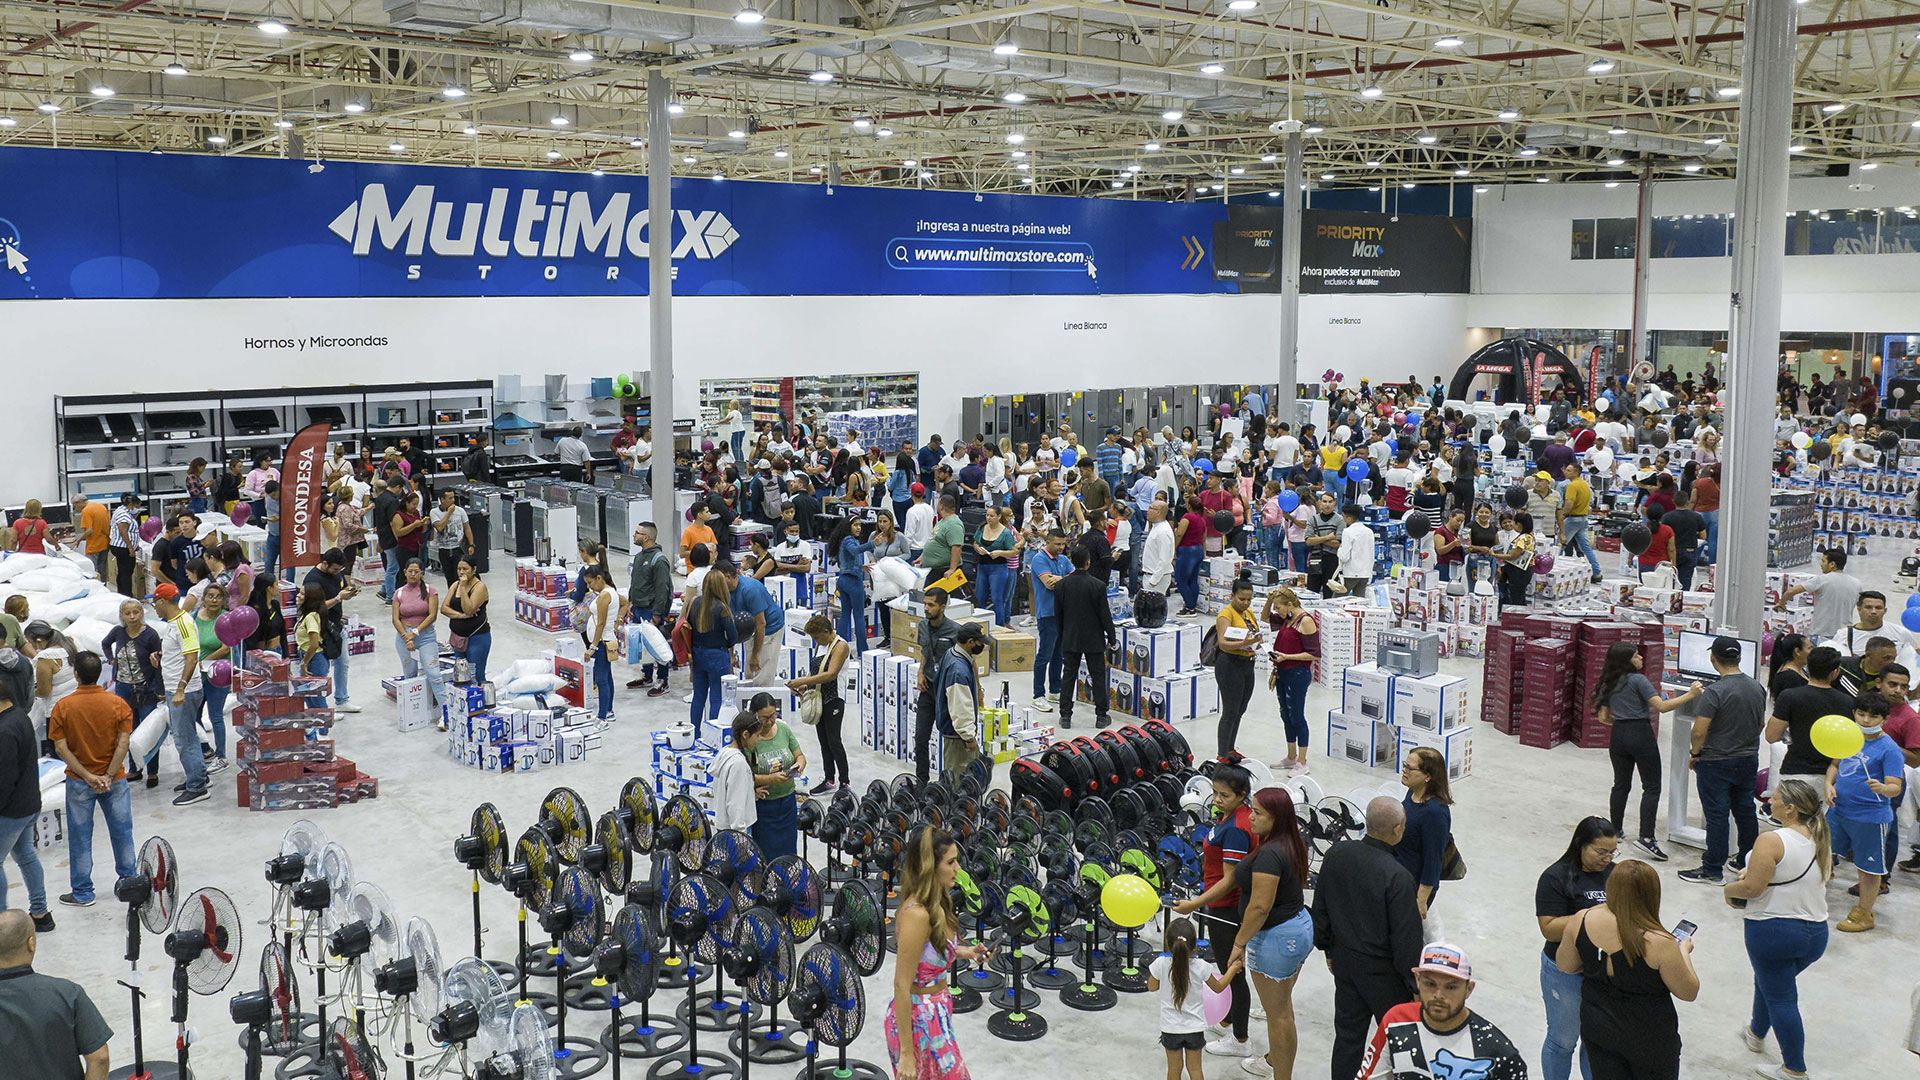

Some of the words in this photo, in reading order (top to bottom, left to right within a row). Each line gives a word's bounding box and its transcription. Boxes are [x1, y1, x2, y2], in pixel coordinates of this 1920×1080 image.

[916, 219, 960, 233] ¡Ingresa
[971, 223, 1010, 233] nuestra
[1012, 222, 1046, 236] página
[1048, 224, 1071, 235] web!
[1316, 224, 1385, 240] PRIORITY
[1254, 238, 1270, 247] Max
[1352, 240, 1380, 258] Max
[914, 246, 1084, 263] www.multimaxstore.com
[1302, 266, 1322, 276] Ahora
[1323, 266, 1349, 278] puedes
[1350, 268, 1360, 276] ser
[1371, 267, 1400, 277] miembro
[244, 337, 295, 349] Hornos
[298, 338, 306, 351] y
[310, 336, 388, 348] Microondas
[294, 447, 314, 536] CONDESA
[410, 684, 422, 693] JVC
